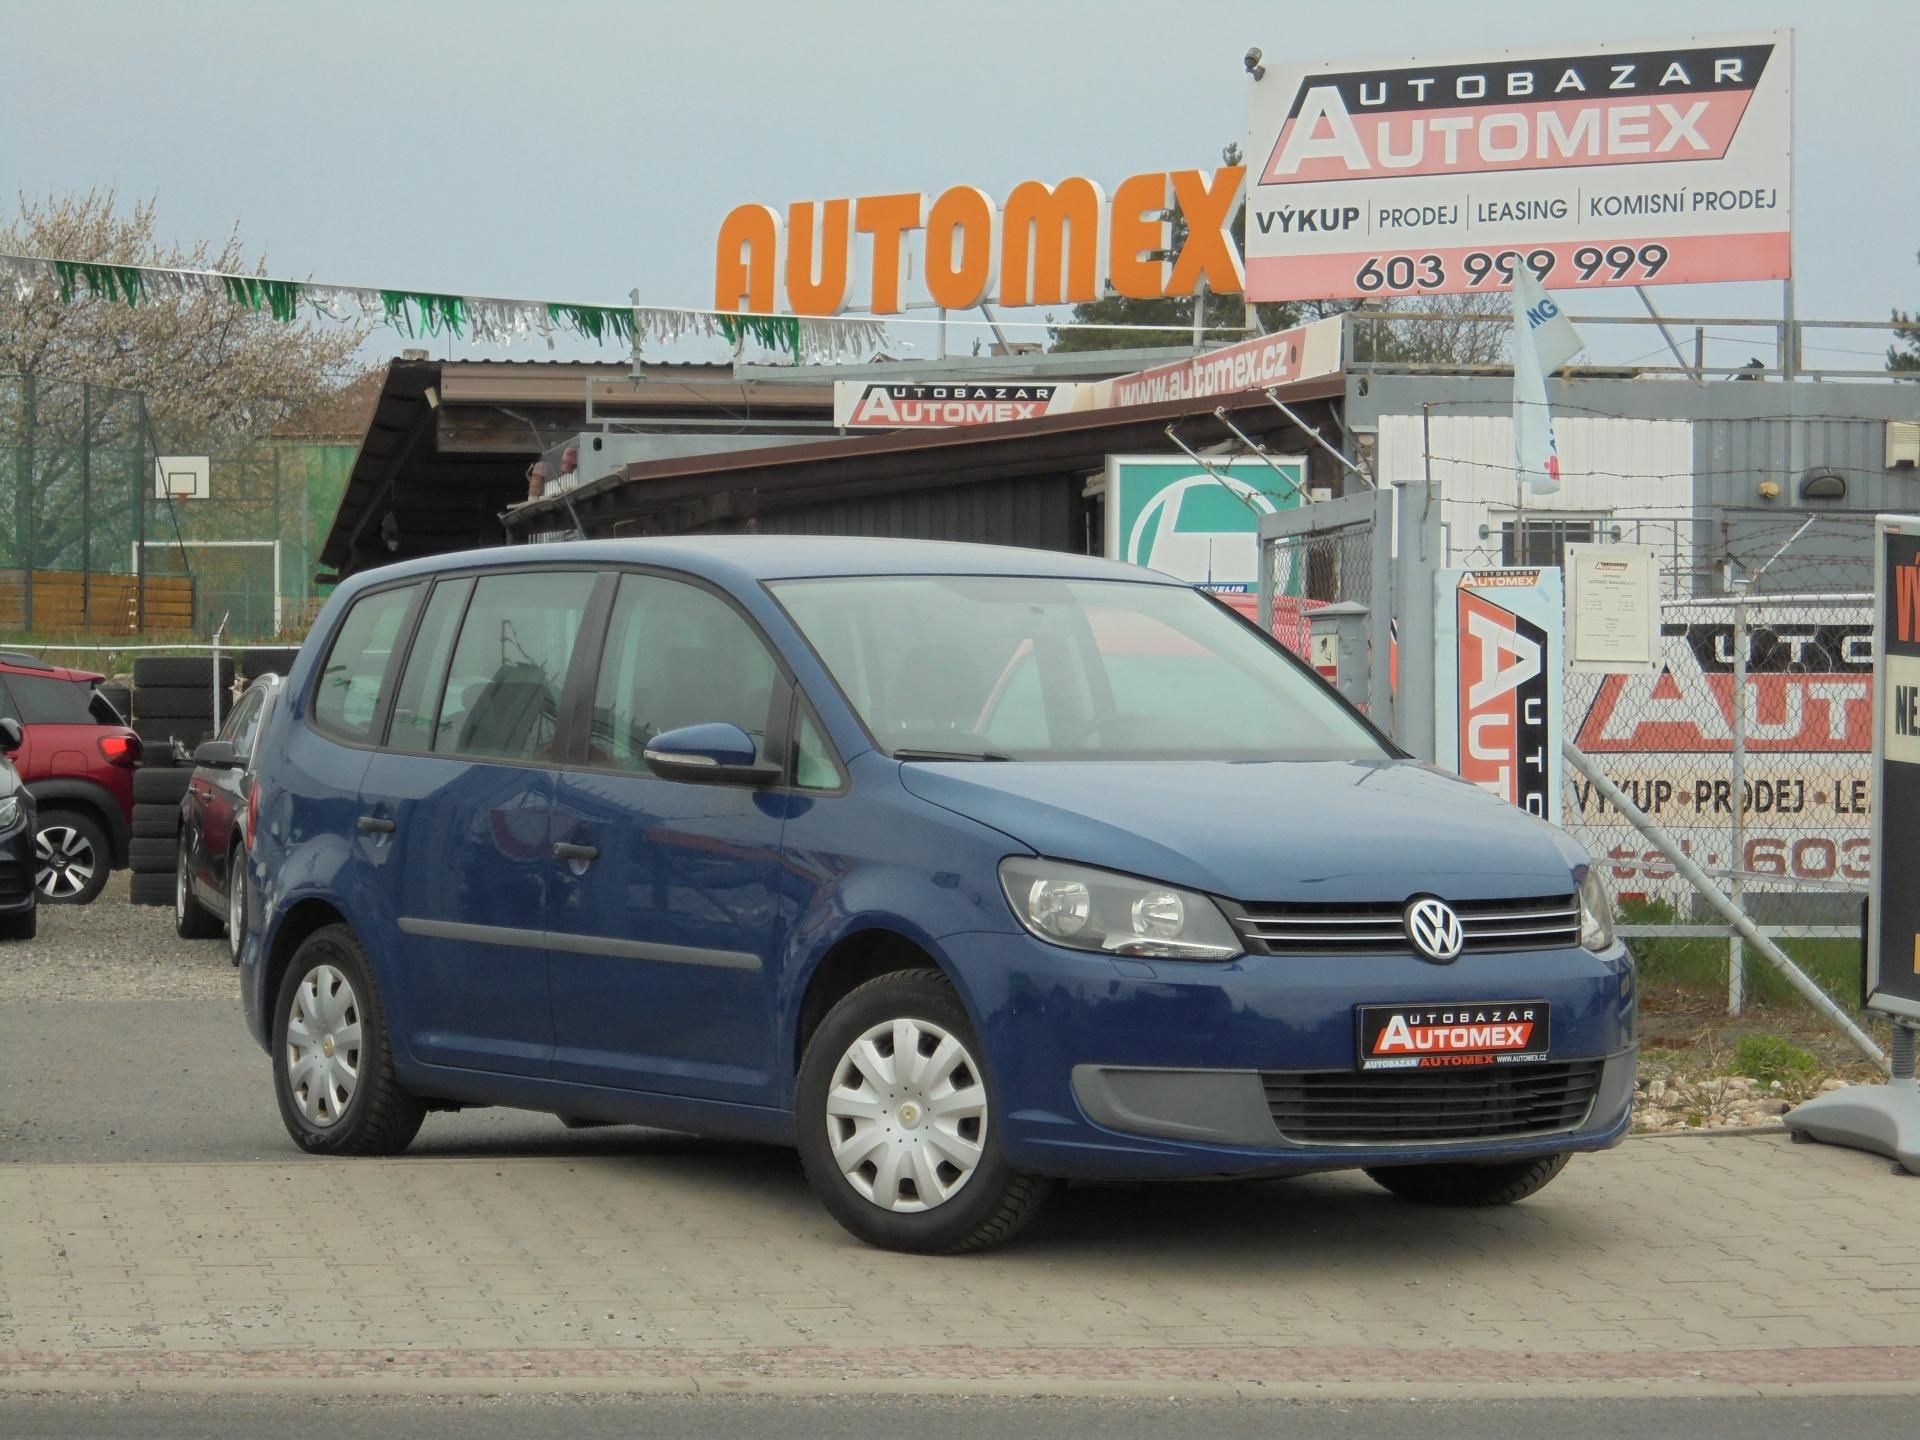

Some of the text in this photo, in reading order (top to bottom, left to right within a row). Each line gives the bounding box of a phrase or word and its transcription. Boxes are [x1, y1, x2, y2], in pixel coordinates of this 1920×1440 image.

[1273, 85, 1711, 176] AUTOMEX
[1256, 187, 1777, 235] VÝKUP PRODEJ LEASING KOMISNÍ PRODEJ
[714, 165, 1246, 316] AUTOMEX
[1355, 244, 1669, 292] 603 999 999
[1119, 341, 1289, 407] www.automex.cz
[857, 387, 1038, 422] AUTOMEX
[1460, 572, 1534, 587] AUTOMEX
[1834, 780, 1872, 814] LE
[1743, 837, 1872, 880] 603
[1379, 1015, 1525, 1050] AUTOMEX
[1364, 1059, 1418, 1069] AUTOBAZAR
[1420, 1055, 1494, 1067] AUTOMEX
